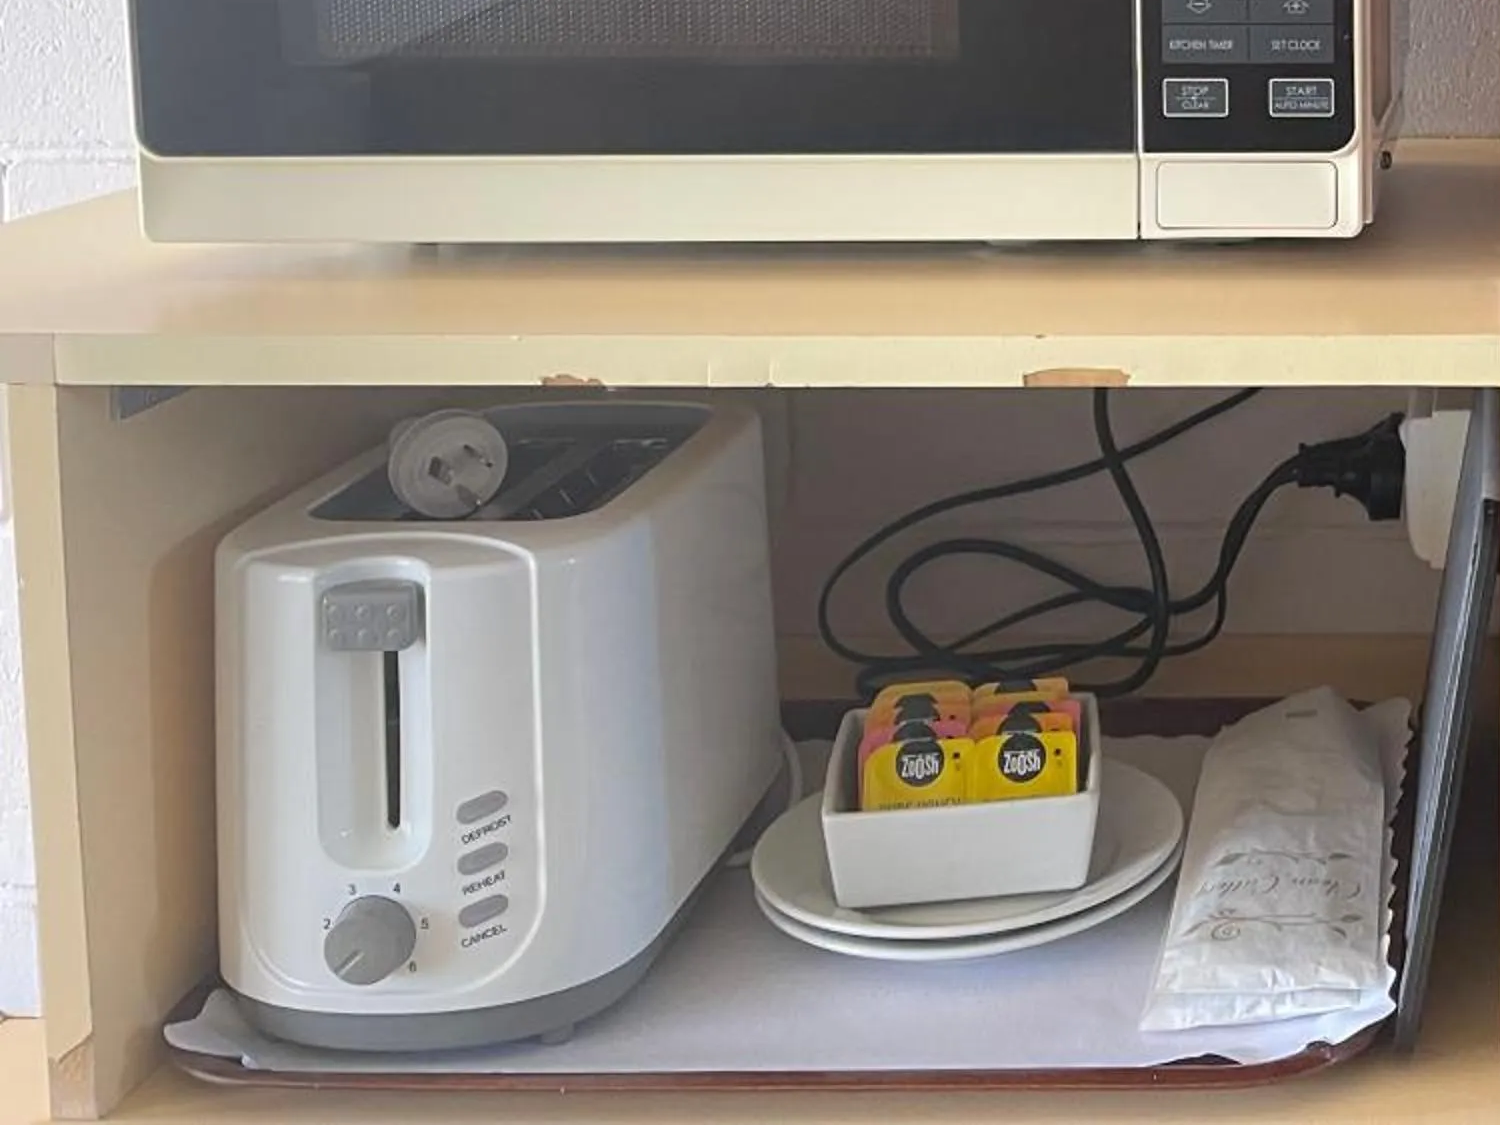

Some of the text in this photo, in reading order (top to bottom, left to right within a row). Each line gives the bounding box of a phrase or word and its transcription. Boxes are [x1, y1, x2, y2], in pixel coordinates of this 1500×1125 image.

[1169, 39, 1234, 50] KITCHEN TIMER
[1271, 39, 1321, 50] SET CLOCK
[1180, 86, 1210, 97] STOP
[1285, 86, 1318, 97] START
[1180, 100, 1210, 110] CLEAR
[461, 814, 512, 845] DEFROST
[393, 883, 401, 893] 4
[461, 870, 506, 896] REHEAT
[323, 918, 332, 930] 2
[461, 924, 508, 949] CANCEL
